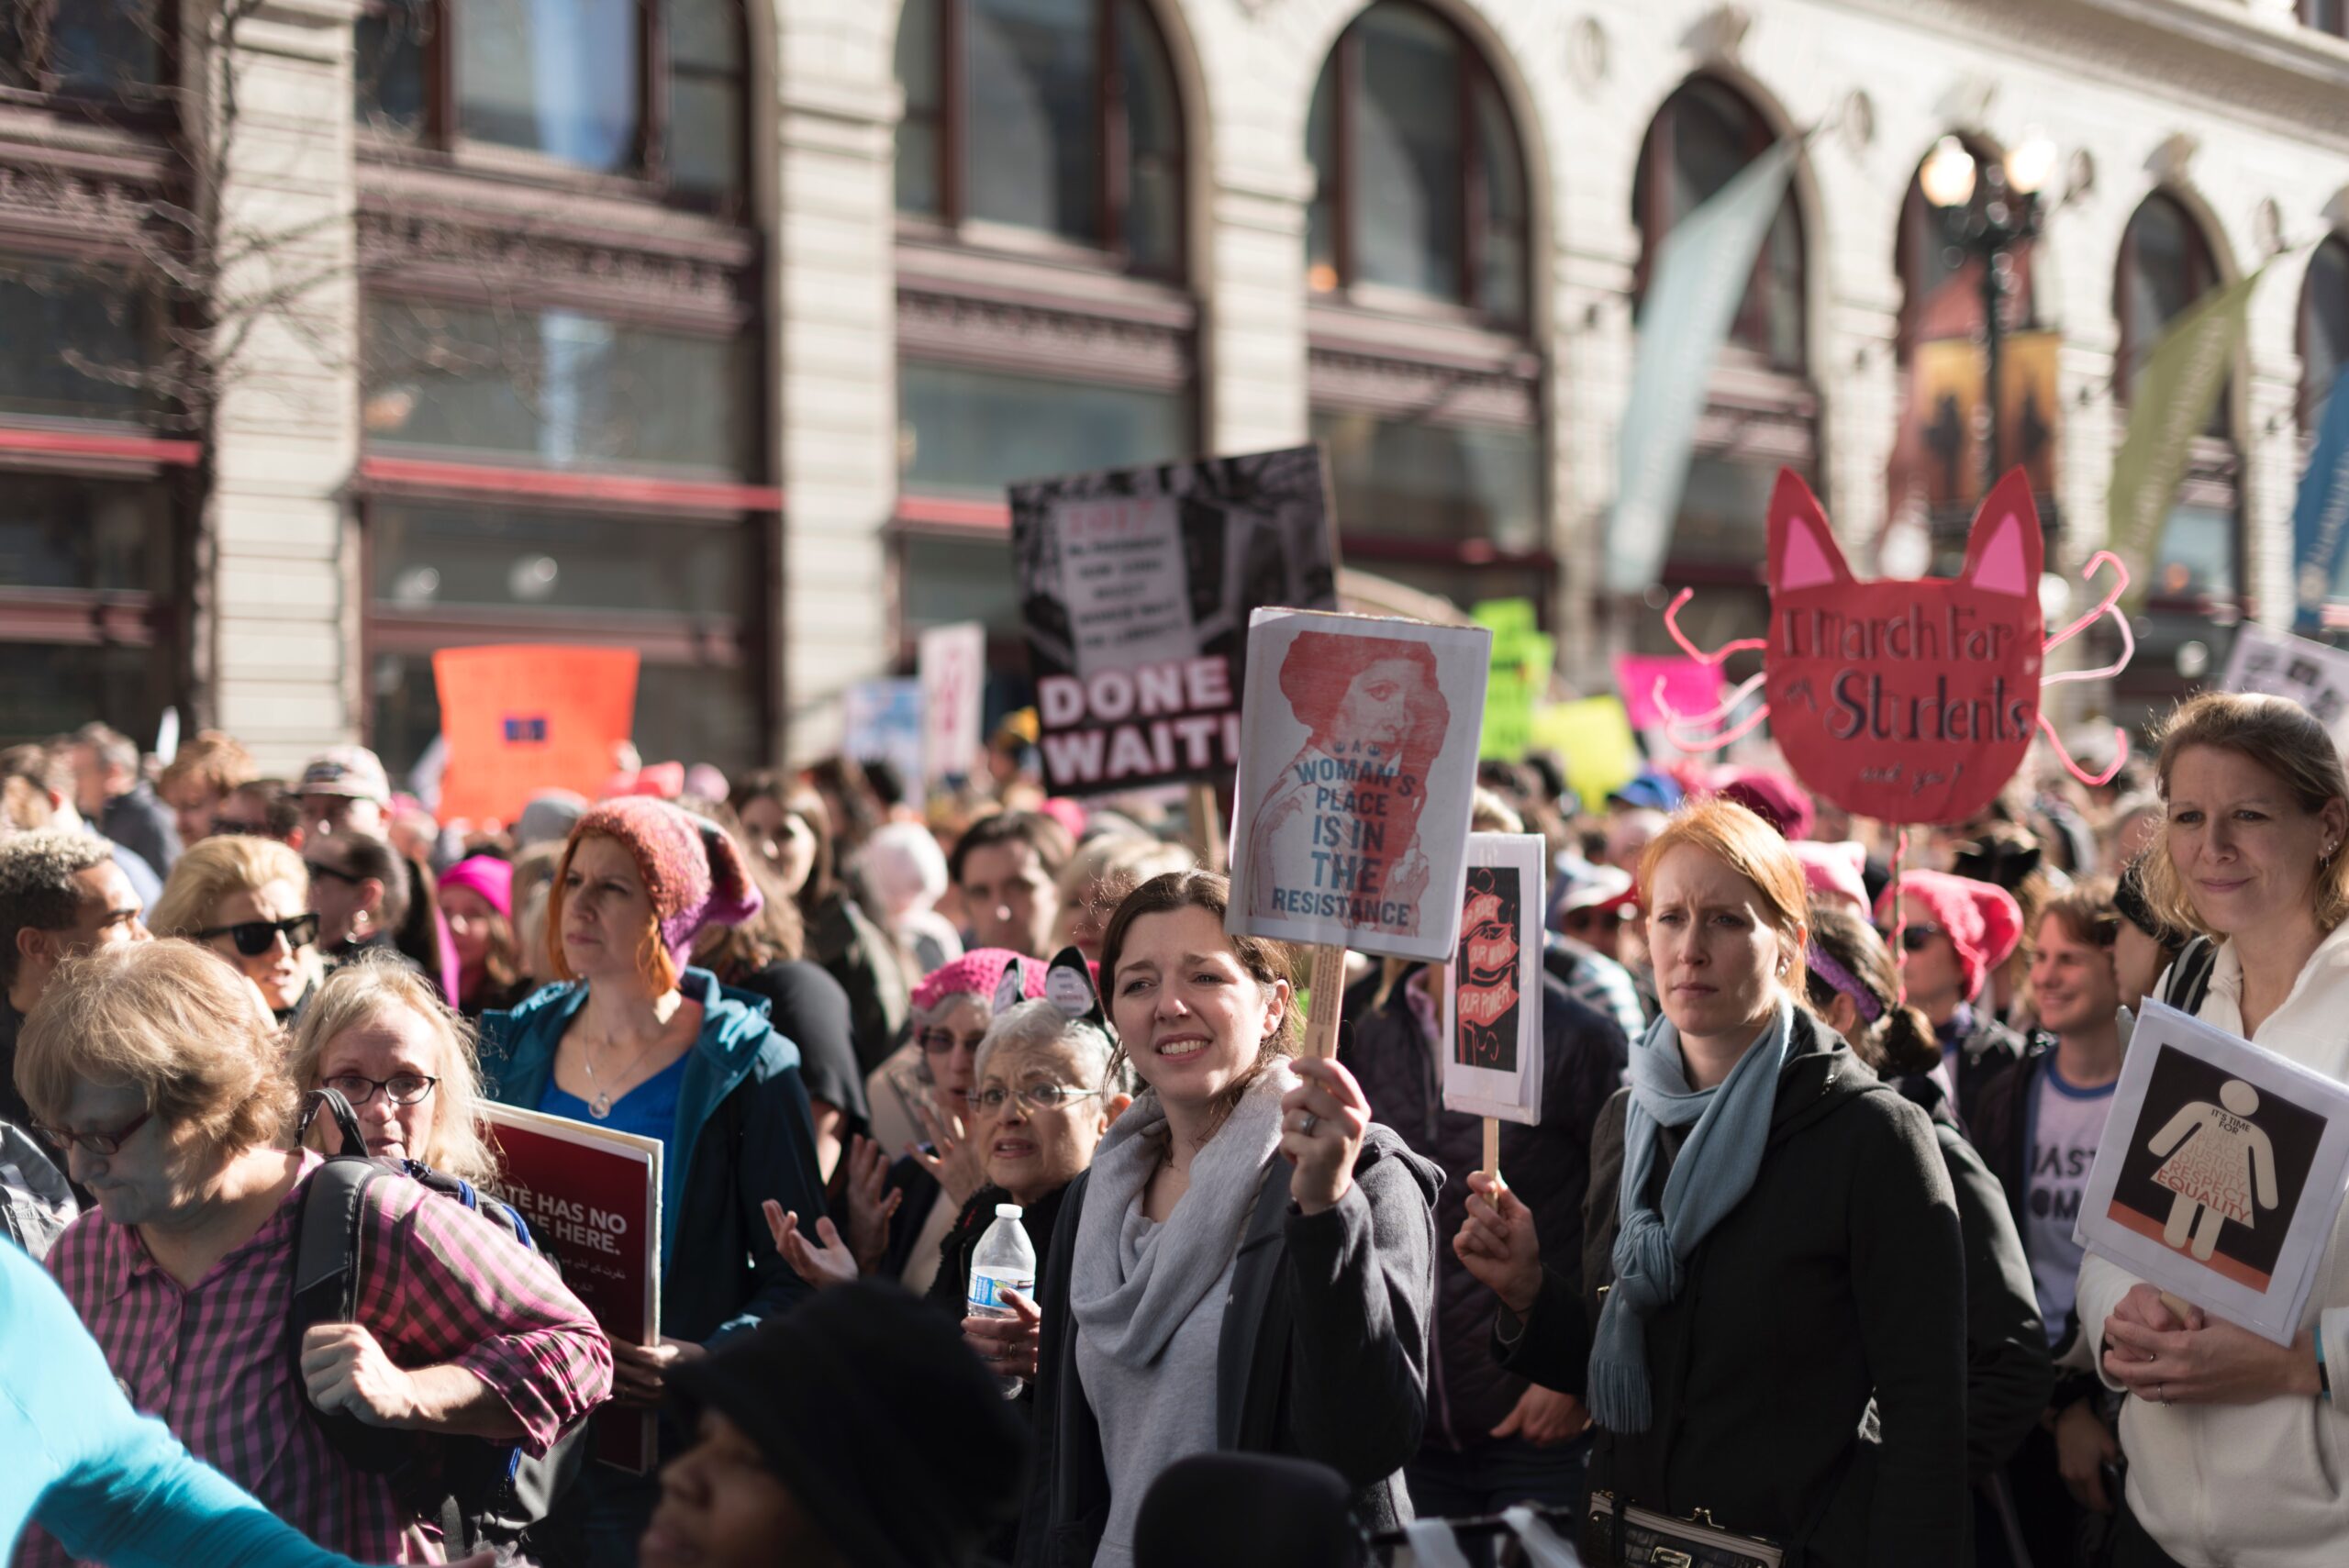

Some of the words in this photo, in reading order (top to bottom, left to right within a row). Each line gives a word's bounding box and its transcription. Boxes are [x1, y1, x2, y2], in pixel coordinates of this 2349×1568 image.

[1782, 609, 1804, 658] I
[1811, 603, 1938, 662] March
[1038, 655, 1232, 728] DONE
[1823, 666, 2034, 742] Students
[1352, 740, 1361, 753] A
[1294, 756, 1417, 796] WOMAN'S
[1316, 788, 1388, 816] PLACE
[1312, 815, 1341, 849] IS
[1352, 821, 1385, 853] IN
[1311, 851, 1383, 894] THE
[1272, 887, 1411, 927] RESISTANCE
[1470, 945, 1487, 963] OUR
[1460, 991, 1480, 1014] OUR
[1480, 981, 1509, 1019] POWER
[2210, 1108, 2228, 1121] IT'S
[2229, 1117, 2252, 1133] TIME
[2218, 1121, 2239, 1135] FOR
[2188, 1143, 2246, 1178] JUSTICE
[2197, 1134, 2245, 1162] PEACE
[2169, 1159, 2249, 1206] RESPECT
[2178, 1151, 2247, 1190] DIGNITY
[484, 1182, 533, 1209] ATE
[537, 1193, 585, 1224] HAS
[589, 1208, 628, 1235] NO
[2156, 1168, 2251, 1222] EQUALITY
[555, 1220, 621, 1256] HERE.
